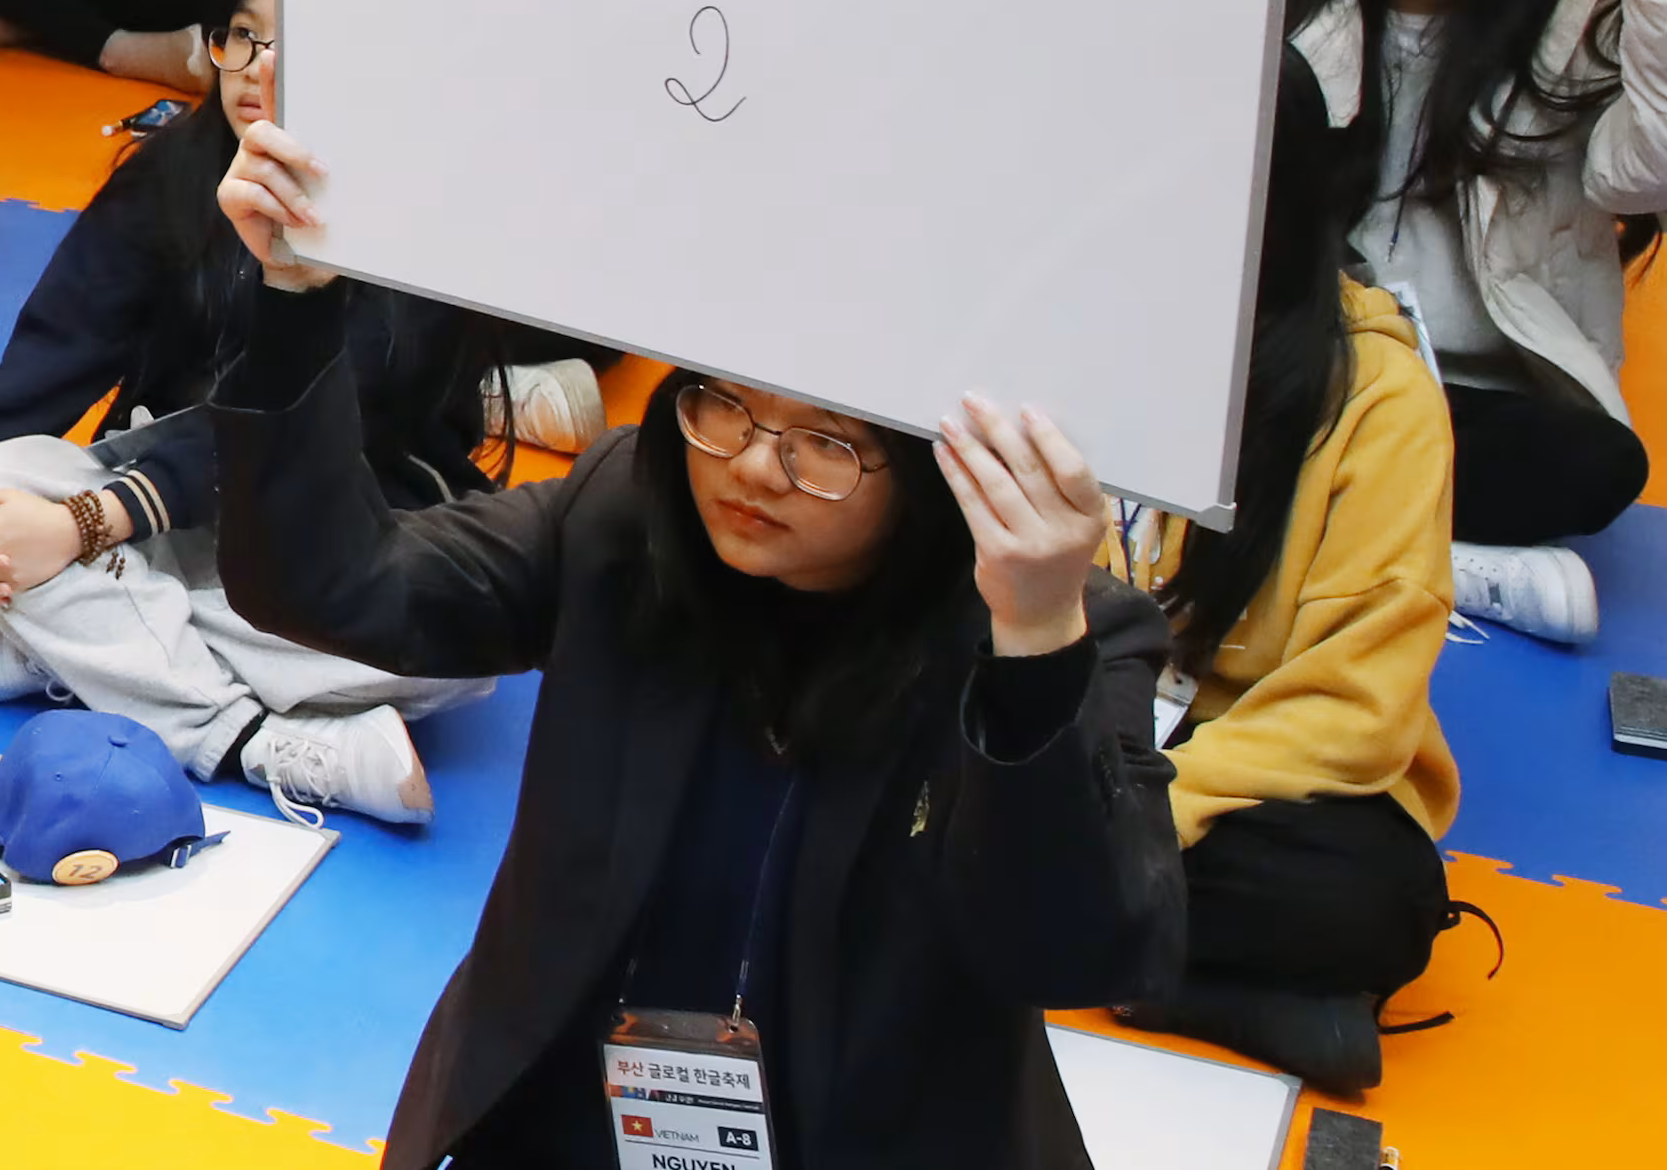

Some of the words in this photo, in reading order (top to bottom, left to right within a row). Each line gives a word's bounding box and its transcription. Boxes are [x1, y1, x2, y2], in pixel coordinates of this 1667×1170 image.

[665, 5, 747, 122] 2
[68, 863, 103, 879] 12
[617, 1059, 644, 1078] 부산
[648, 1063, 690, 1083] 글로컬
[693, 1068, 751, 1090] 한글축제
[655, 1130, 700, 1143] VIETNAM
[725, 1132, 752, 1146] A-8
